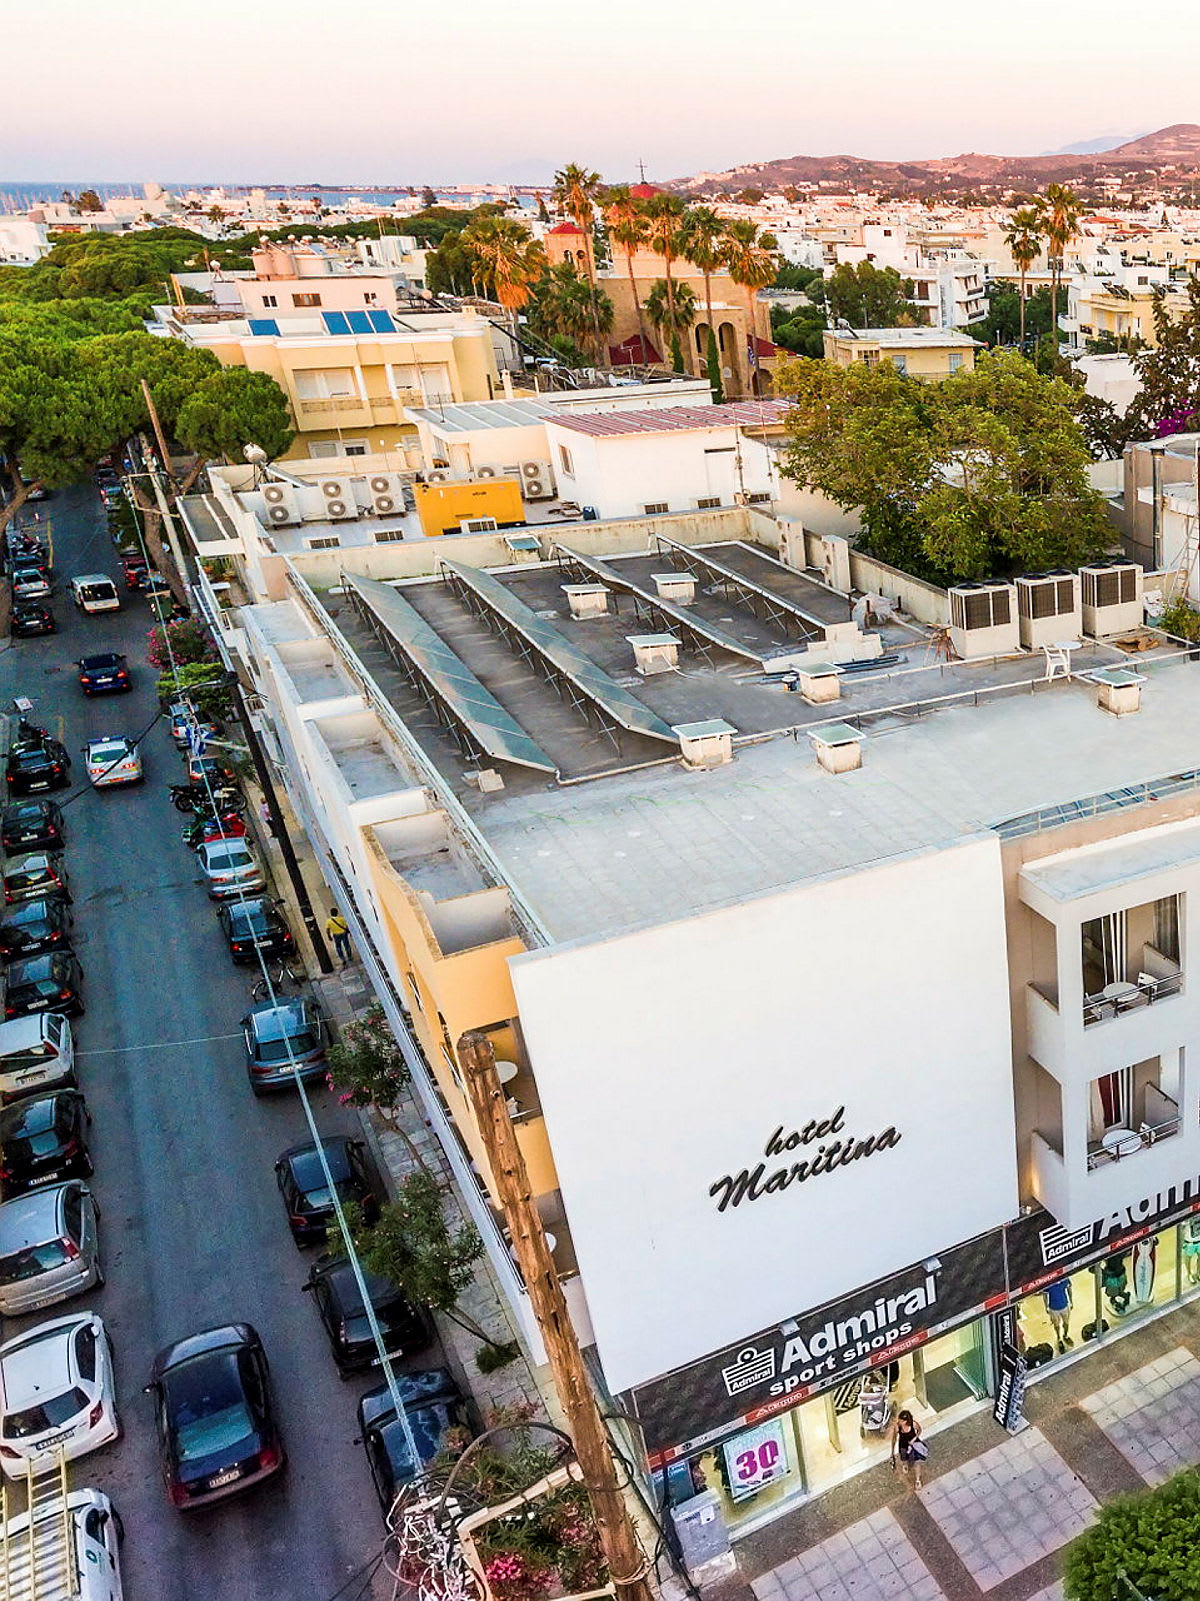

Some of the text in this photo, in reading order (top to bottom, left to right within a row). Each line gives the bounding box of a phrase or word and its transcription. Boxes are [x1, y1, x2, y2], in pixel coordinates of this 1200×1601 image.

[765, 1106, 845, 1157] hotel
[709, 1125, 902, 1212] Maritina
[1048, 1231, 1090, 1259] Admiral
[780, 1275, 937, 1374] Admiral
[732, 1368, 771, 1391] Admiral
[769, 1354, 837, 1397] sport
[843, 1322, 912, 1363] shops
[995, 1369, 1012, 1424] Admiral
[736, 1440, 779, 1480] 30
